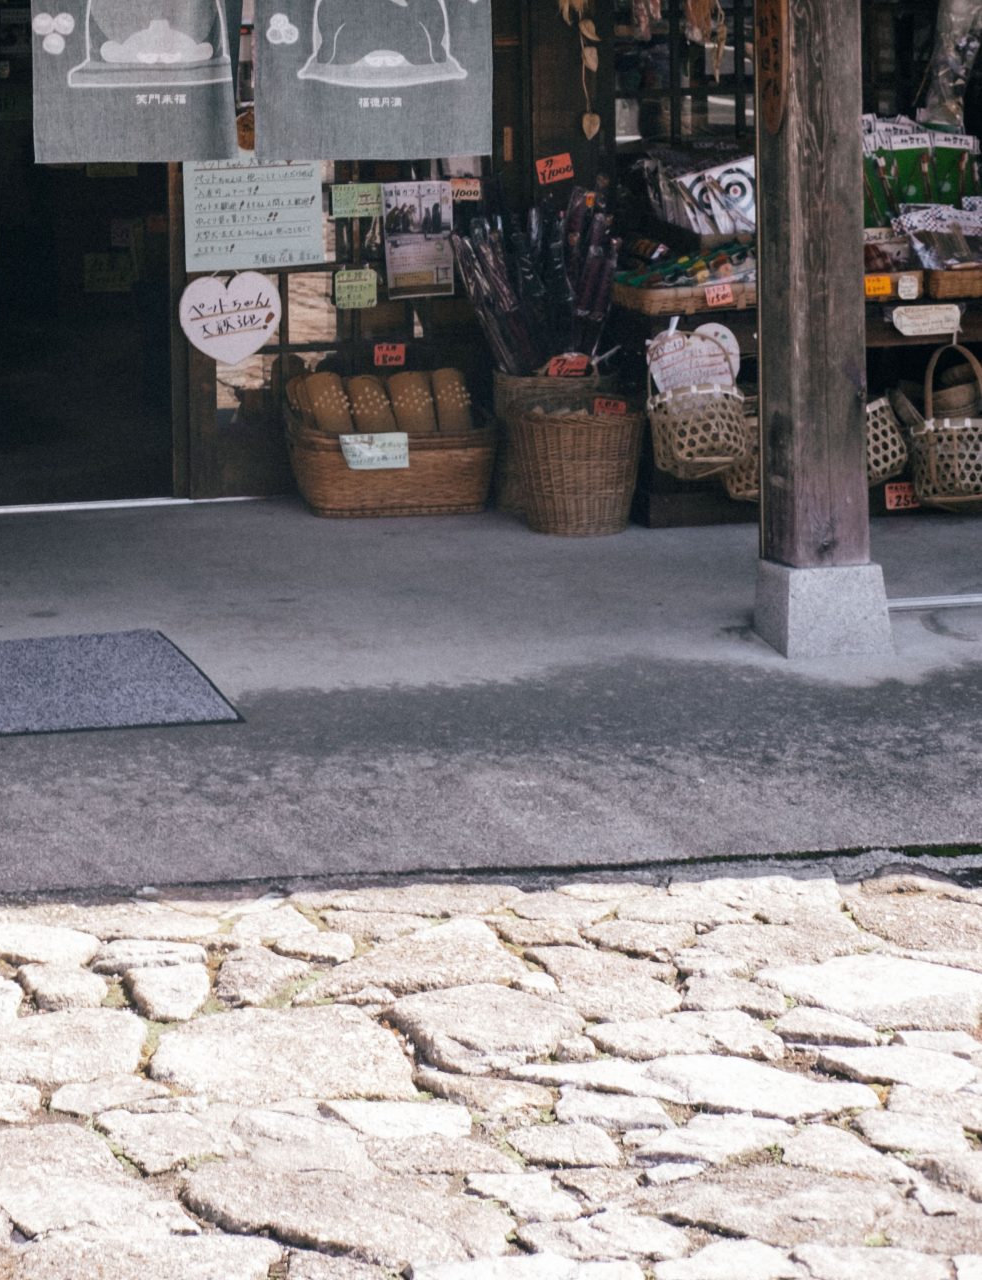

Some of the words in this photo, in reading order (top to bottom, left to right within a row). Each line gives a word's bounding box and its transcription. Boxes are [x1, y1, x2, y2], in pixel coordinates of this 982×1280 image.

[135, 93, 187, 106] 笑門来福
[189, 292, 270, 317] ペットちゃん
